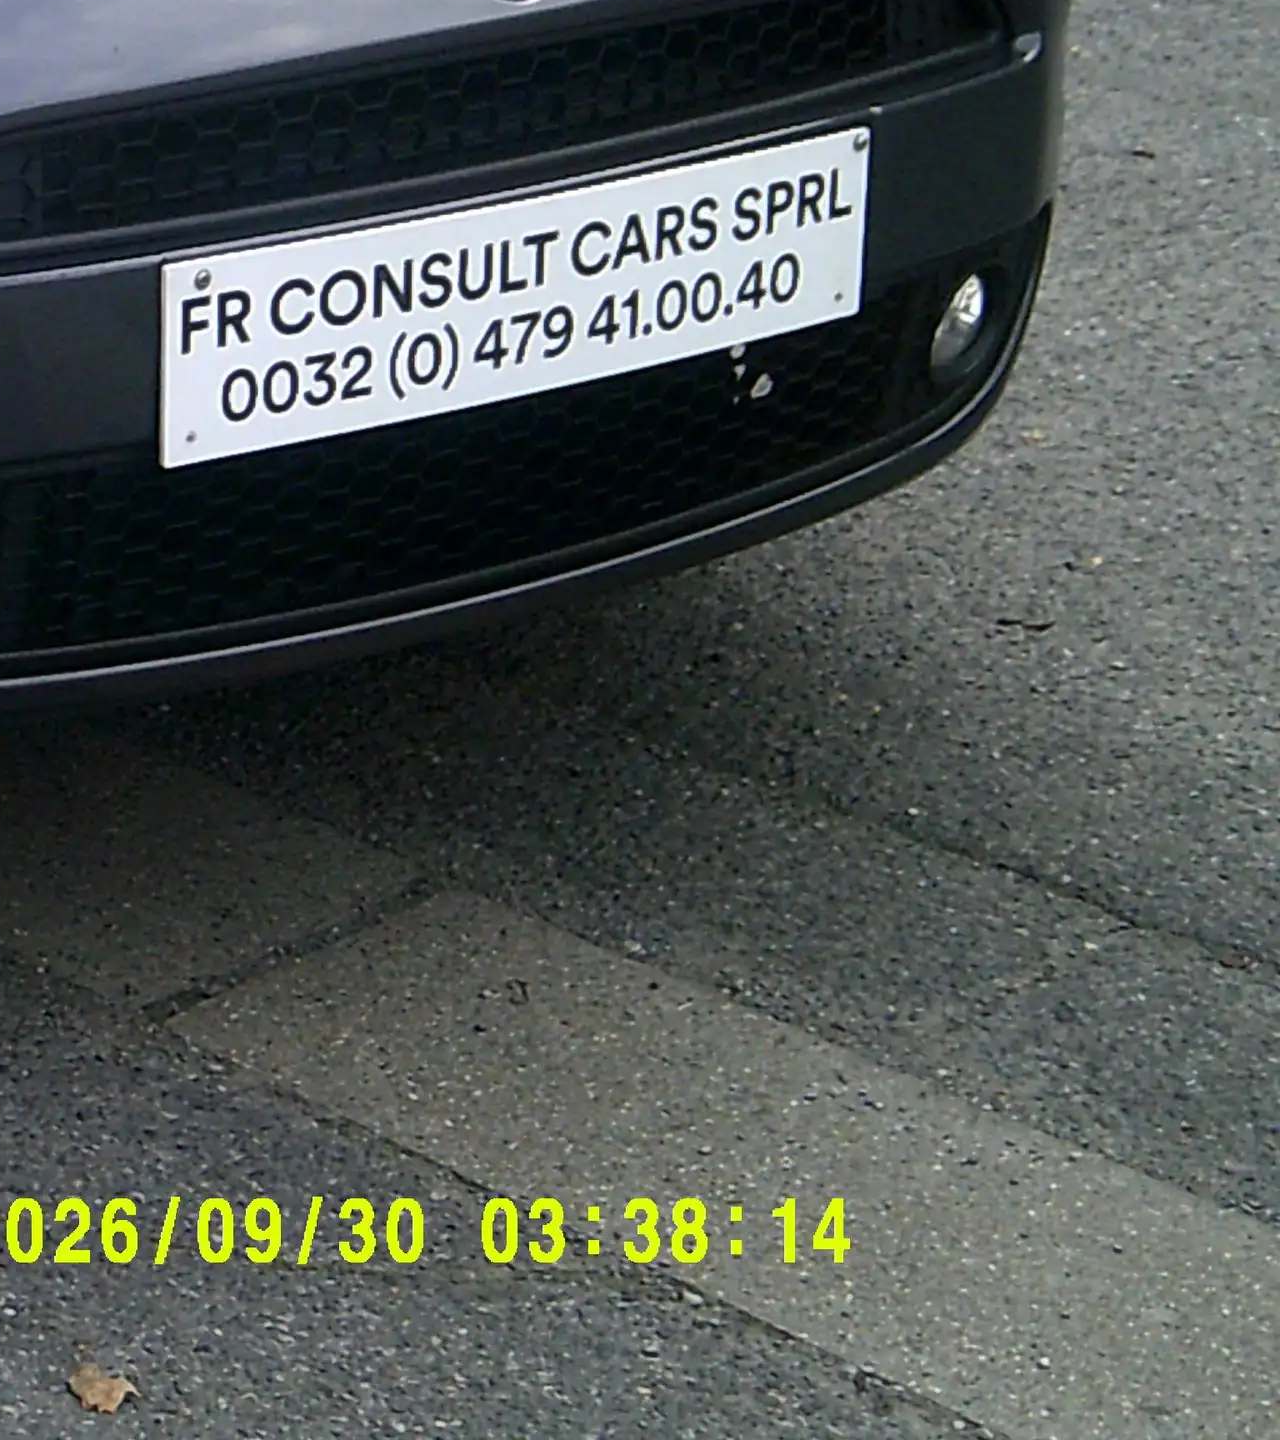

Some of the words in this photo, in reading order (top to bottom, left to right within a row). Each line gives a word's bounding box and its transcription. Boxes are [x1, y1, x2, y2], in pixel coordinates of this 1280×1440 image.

[181, 289, 252, 355] FR
[269, 230, 560, 336] CONSULT
[570, 197, 720, 277] CARS
[731, 167, 853, 241] SPRL
[221, 345, 373, 422] 0032
[389, 322, 459, 400] (0)
[472, 305, 574, 369] 479
[587, 252, 801, 345] 41.00.40
